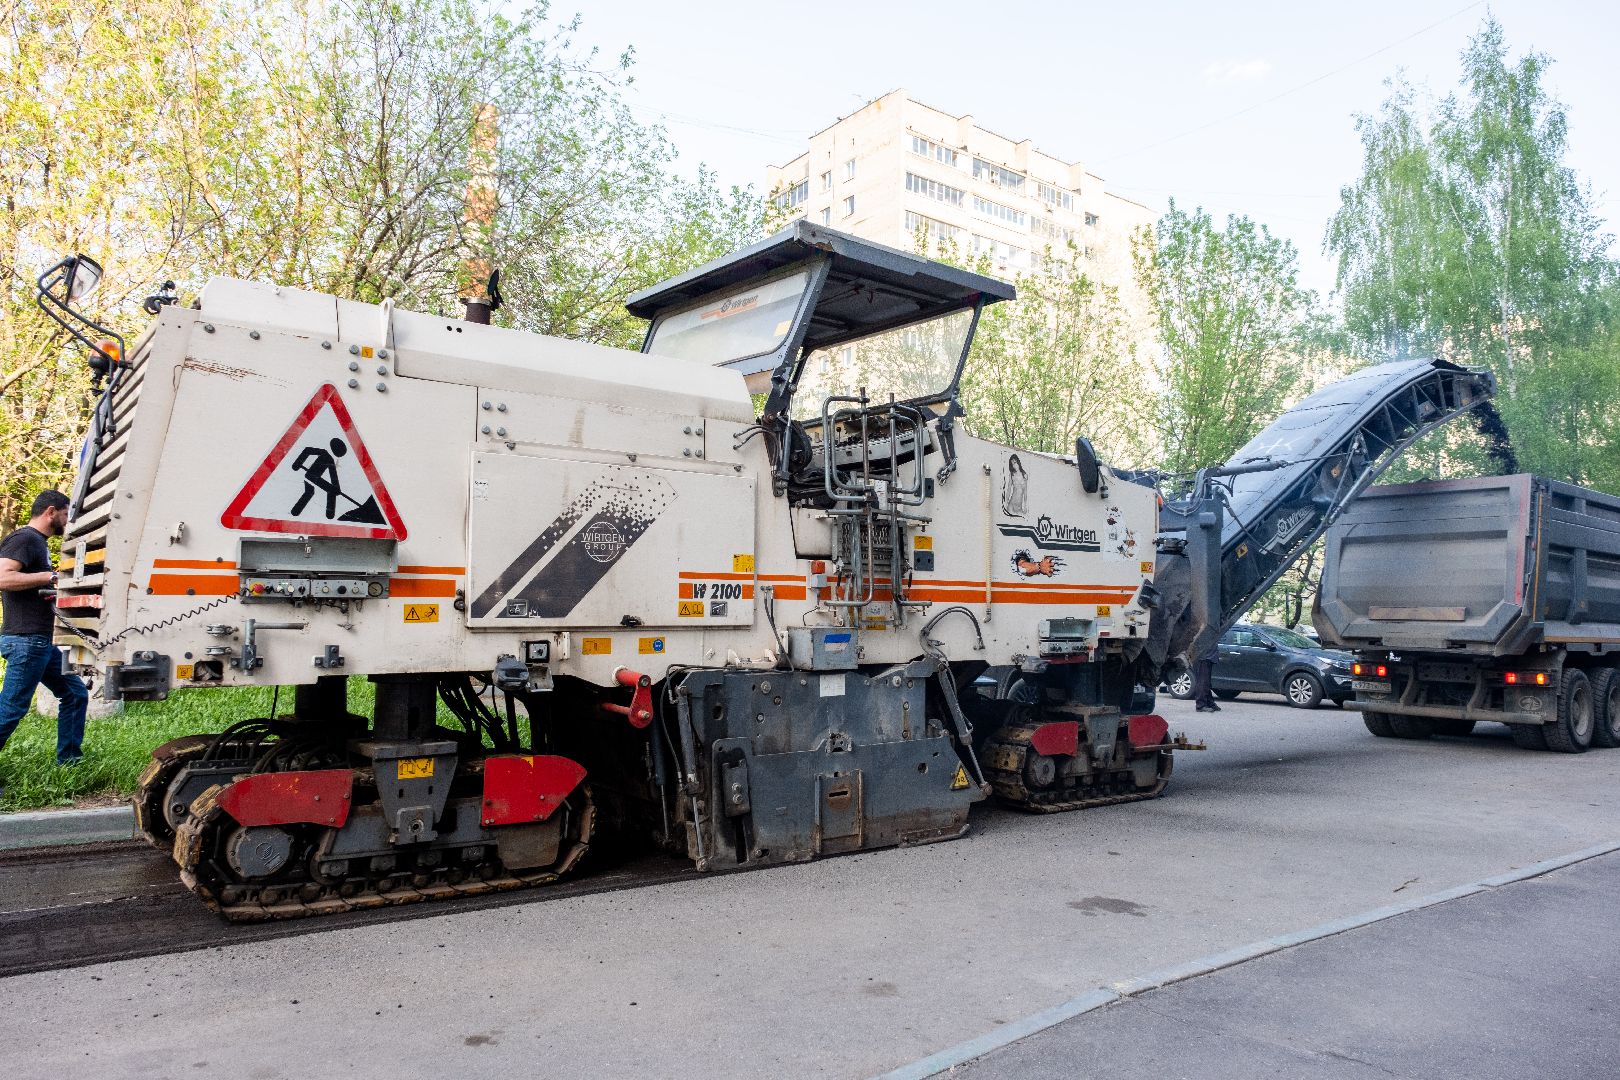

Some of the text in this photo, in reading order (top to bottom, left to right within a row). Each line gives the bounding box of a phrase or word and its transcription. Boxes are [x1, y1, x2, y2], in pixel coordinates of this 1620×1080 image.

[581, 532, 625, 543] WIRTGEN
[1054, 524, 1096, 543] Wirtgen
[584, 542, 622, 550] GROUP
[693, 583, 742, 599] W 2100
